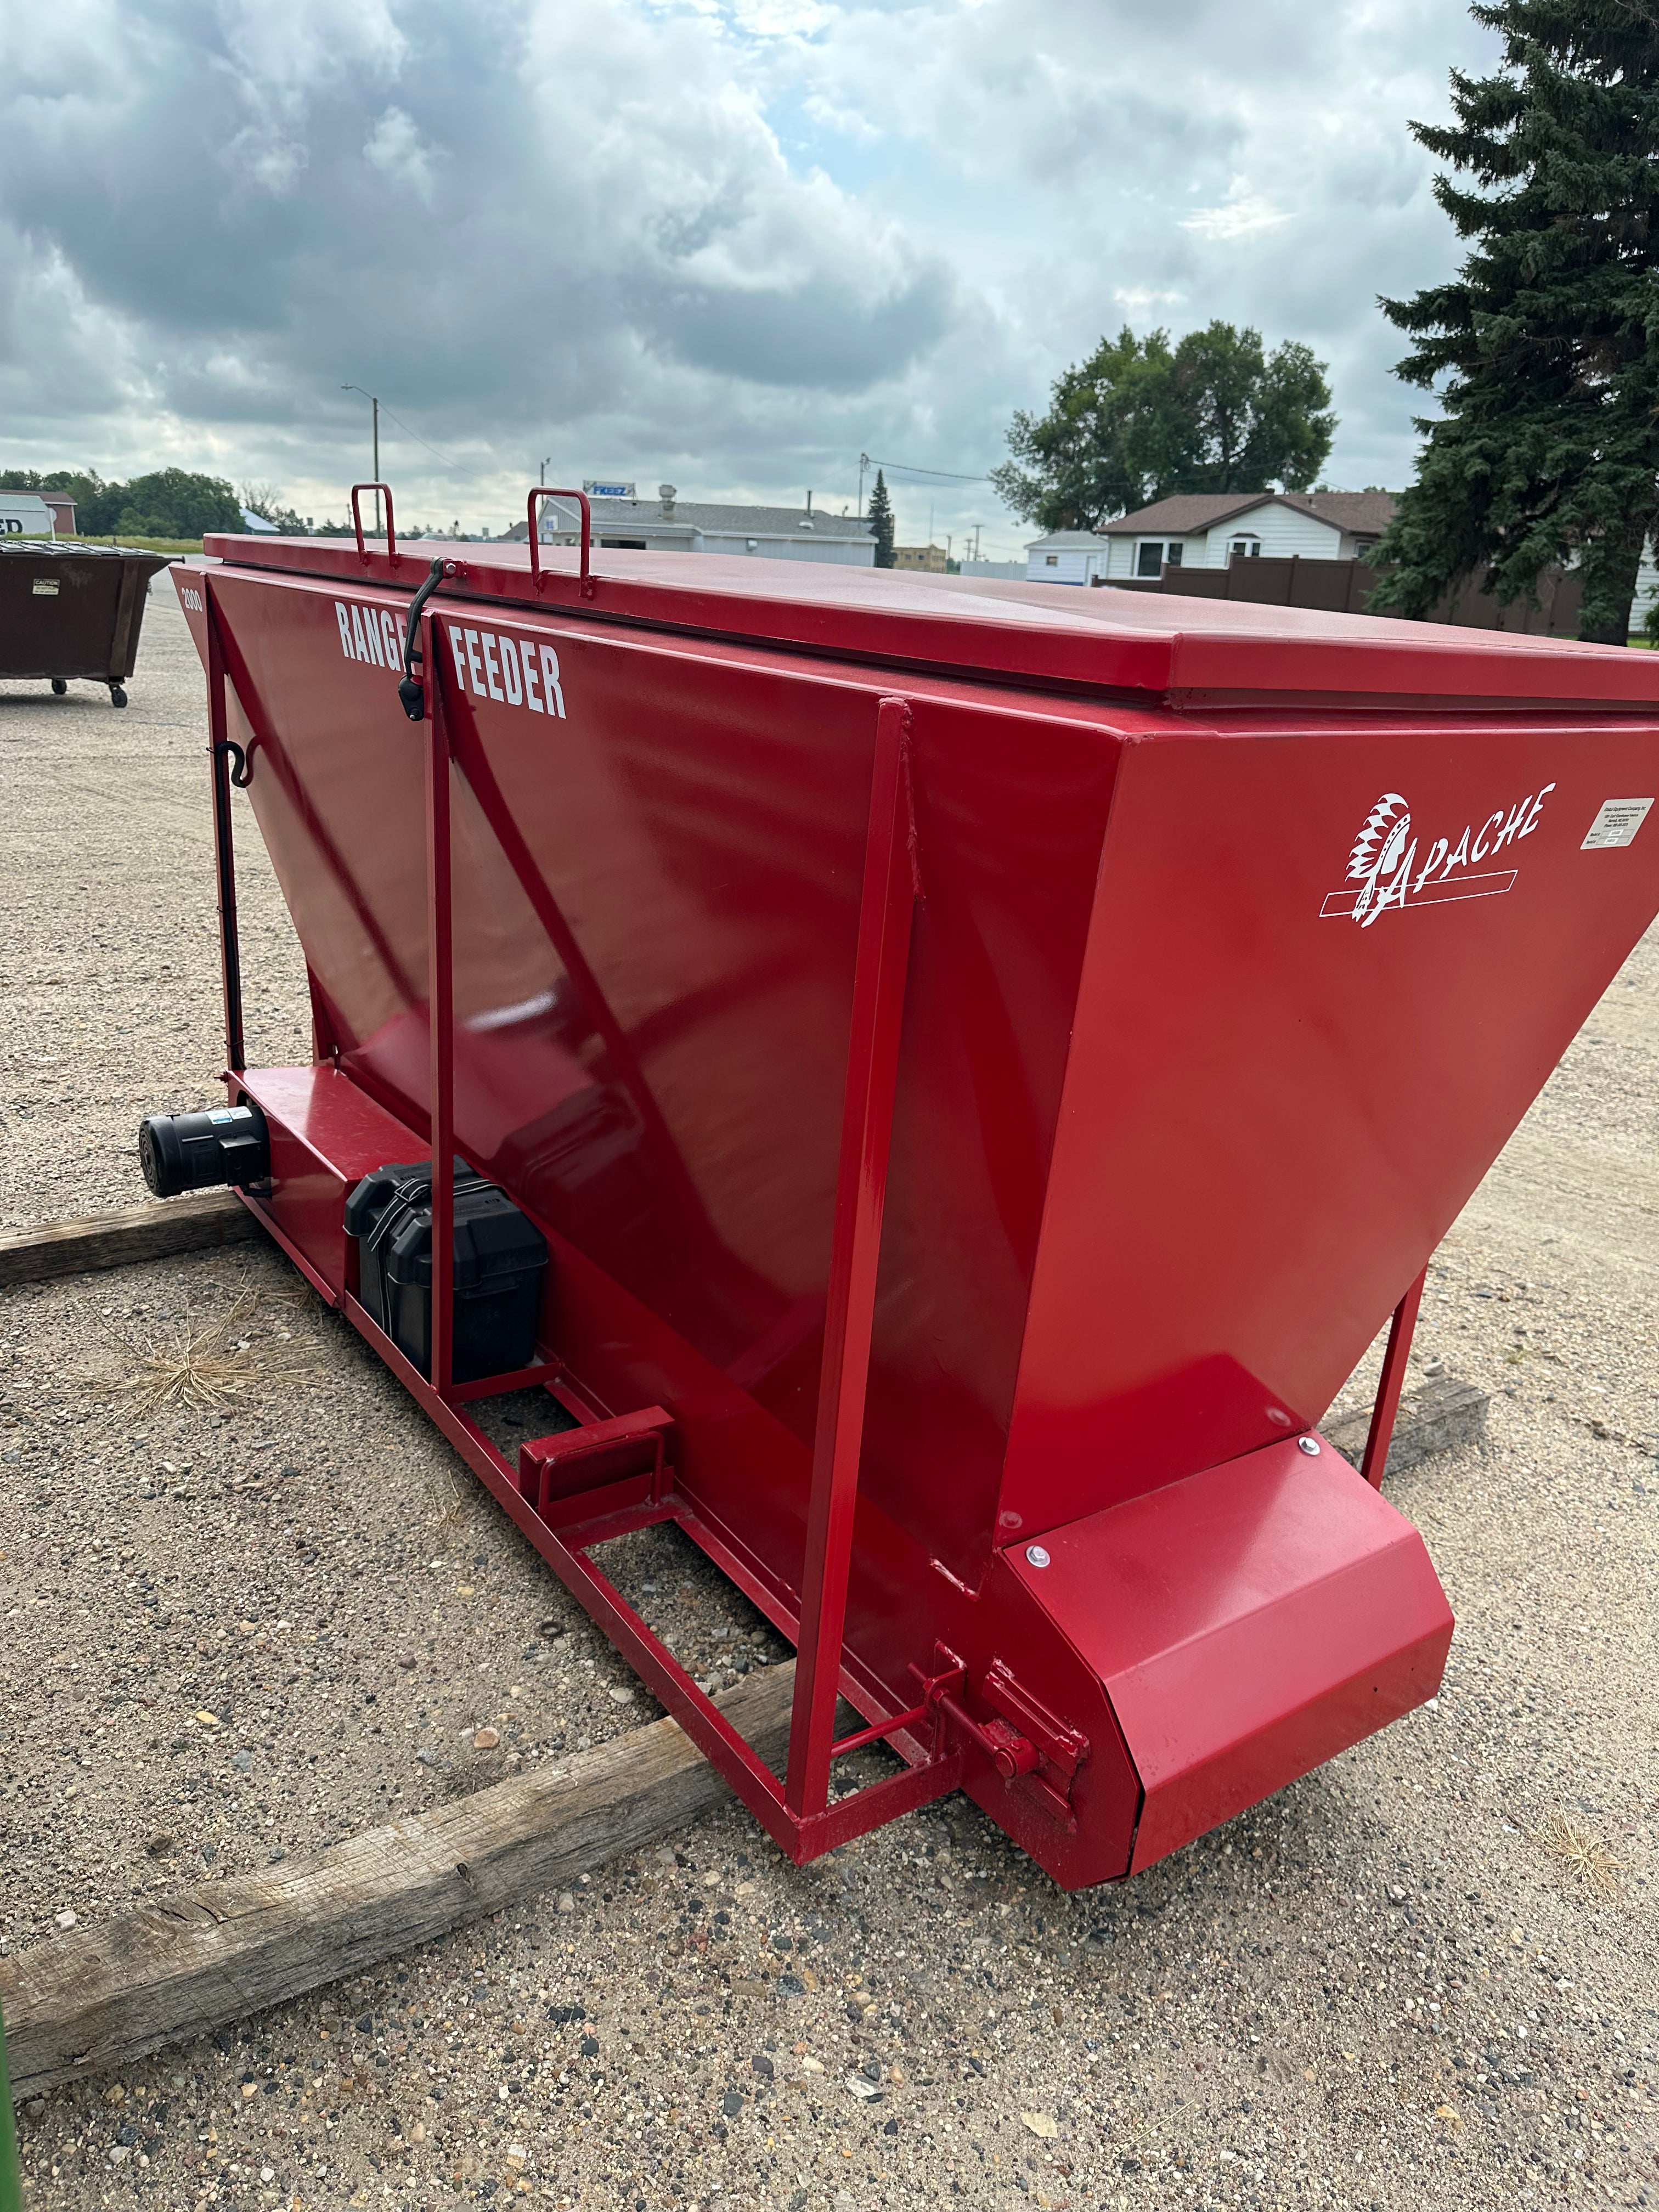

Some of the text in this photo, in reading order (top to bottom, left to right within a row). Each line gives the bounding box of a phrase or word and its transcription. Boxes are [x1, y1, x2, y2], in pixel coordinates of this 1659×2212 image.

[182, 587, 202, 612] 2000
[449, 625, 566, 719] FEEDER
[1361, 782, 1556, 928] APACHE
